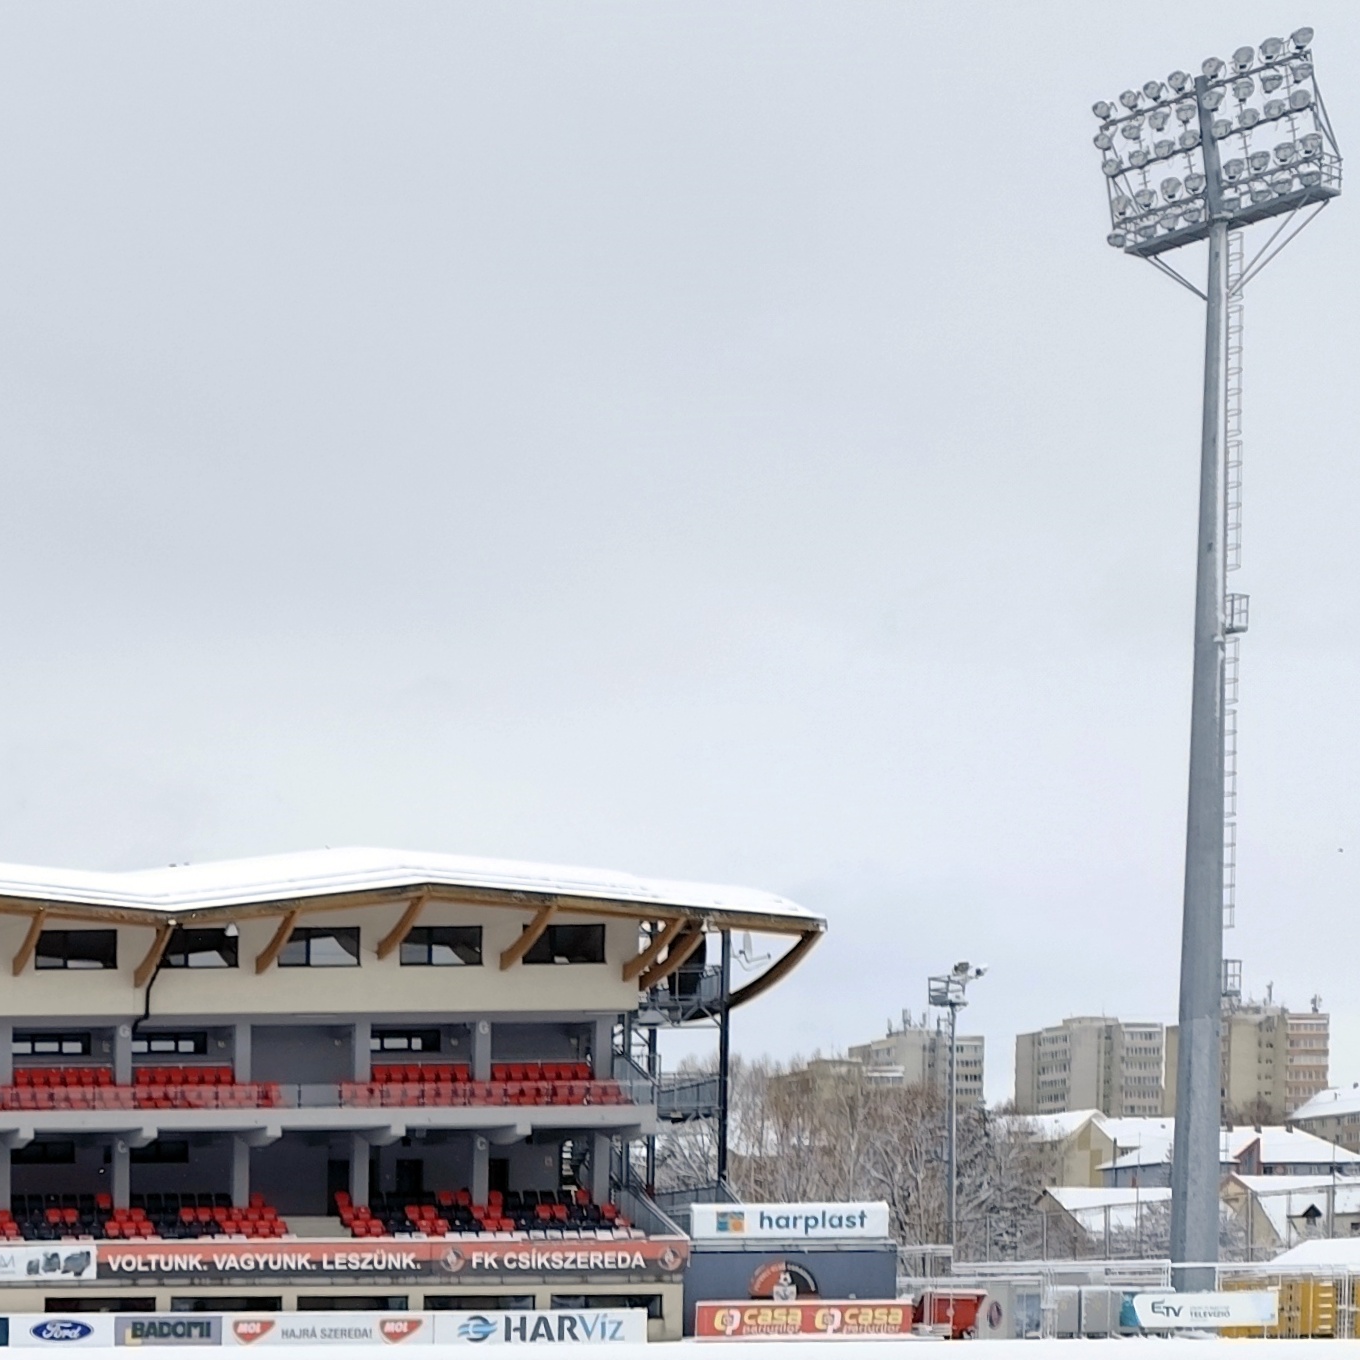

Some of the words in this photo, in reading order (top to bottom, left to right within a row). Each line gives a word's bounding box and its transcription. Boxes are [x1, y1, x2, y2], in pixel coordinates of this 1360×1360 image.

[760, 1210, 867, 1234] harplast
[108, 1254, 208, 1272] VOLTUNK.
[213, 1252, 316, 1271] VAGYUNK.
[322, 1249, 421, 1270] LESZÜNK.
[471, 1250, 498, 1269] FK
[503, 1247, 646, 1268] CSÍKSZEREDA
[744, 1308, 802, 1325] casa
[844, 1308, 903, 1325] casa
[42, 1322, 81, 1339] Ford
[132, 1321, 211, 1338] BADOMI
[281, 1325, 317, 1339] HAJRÁ
[320, 1327, 372, 1339] SZEREDA!
[384, 1321, 409, 1332] MOL
[504, 1313, 625, 1342] HARVíz
